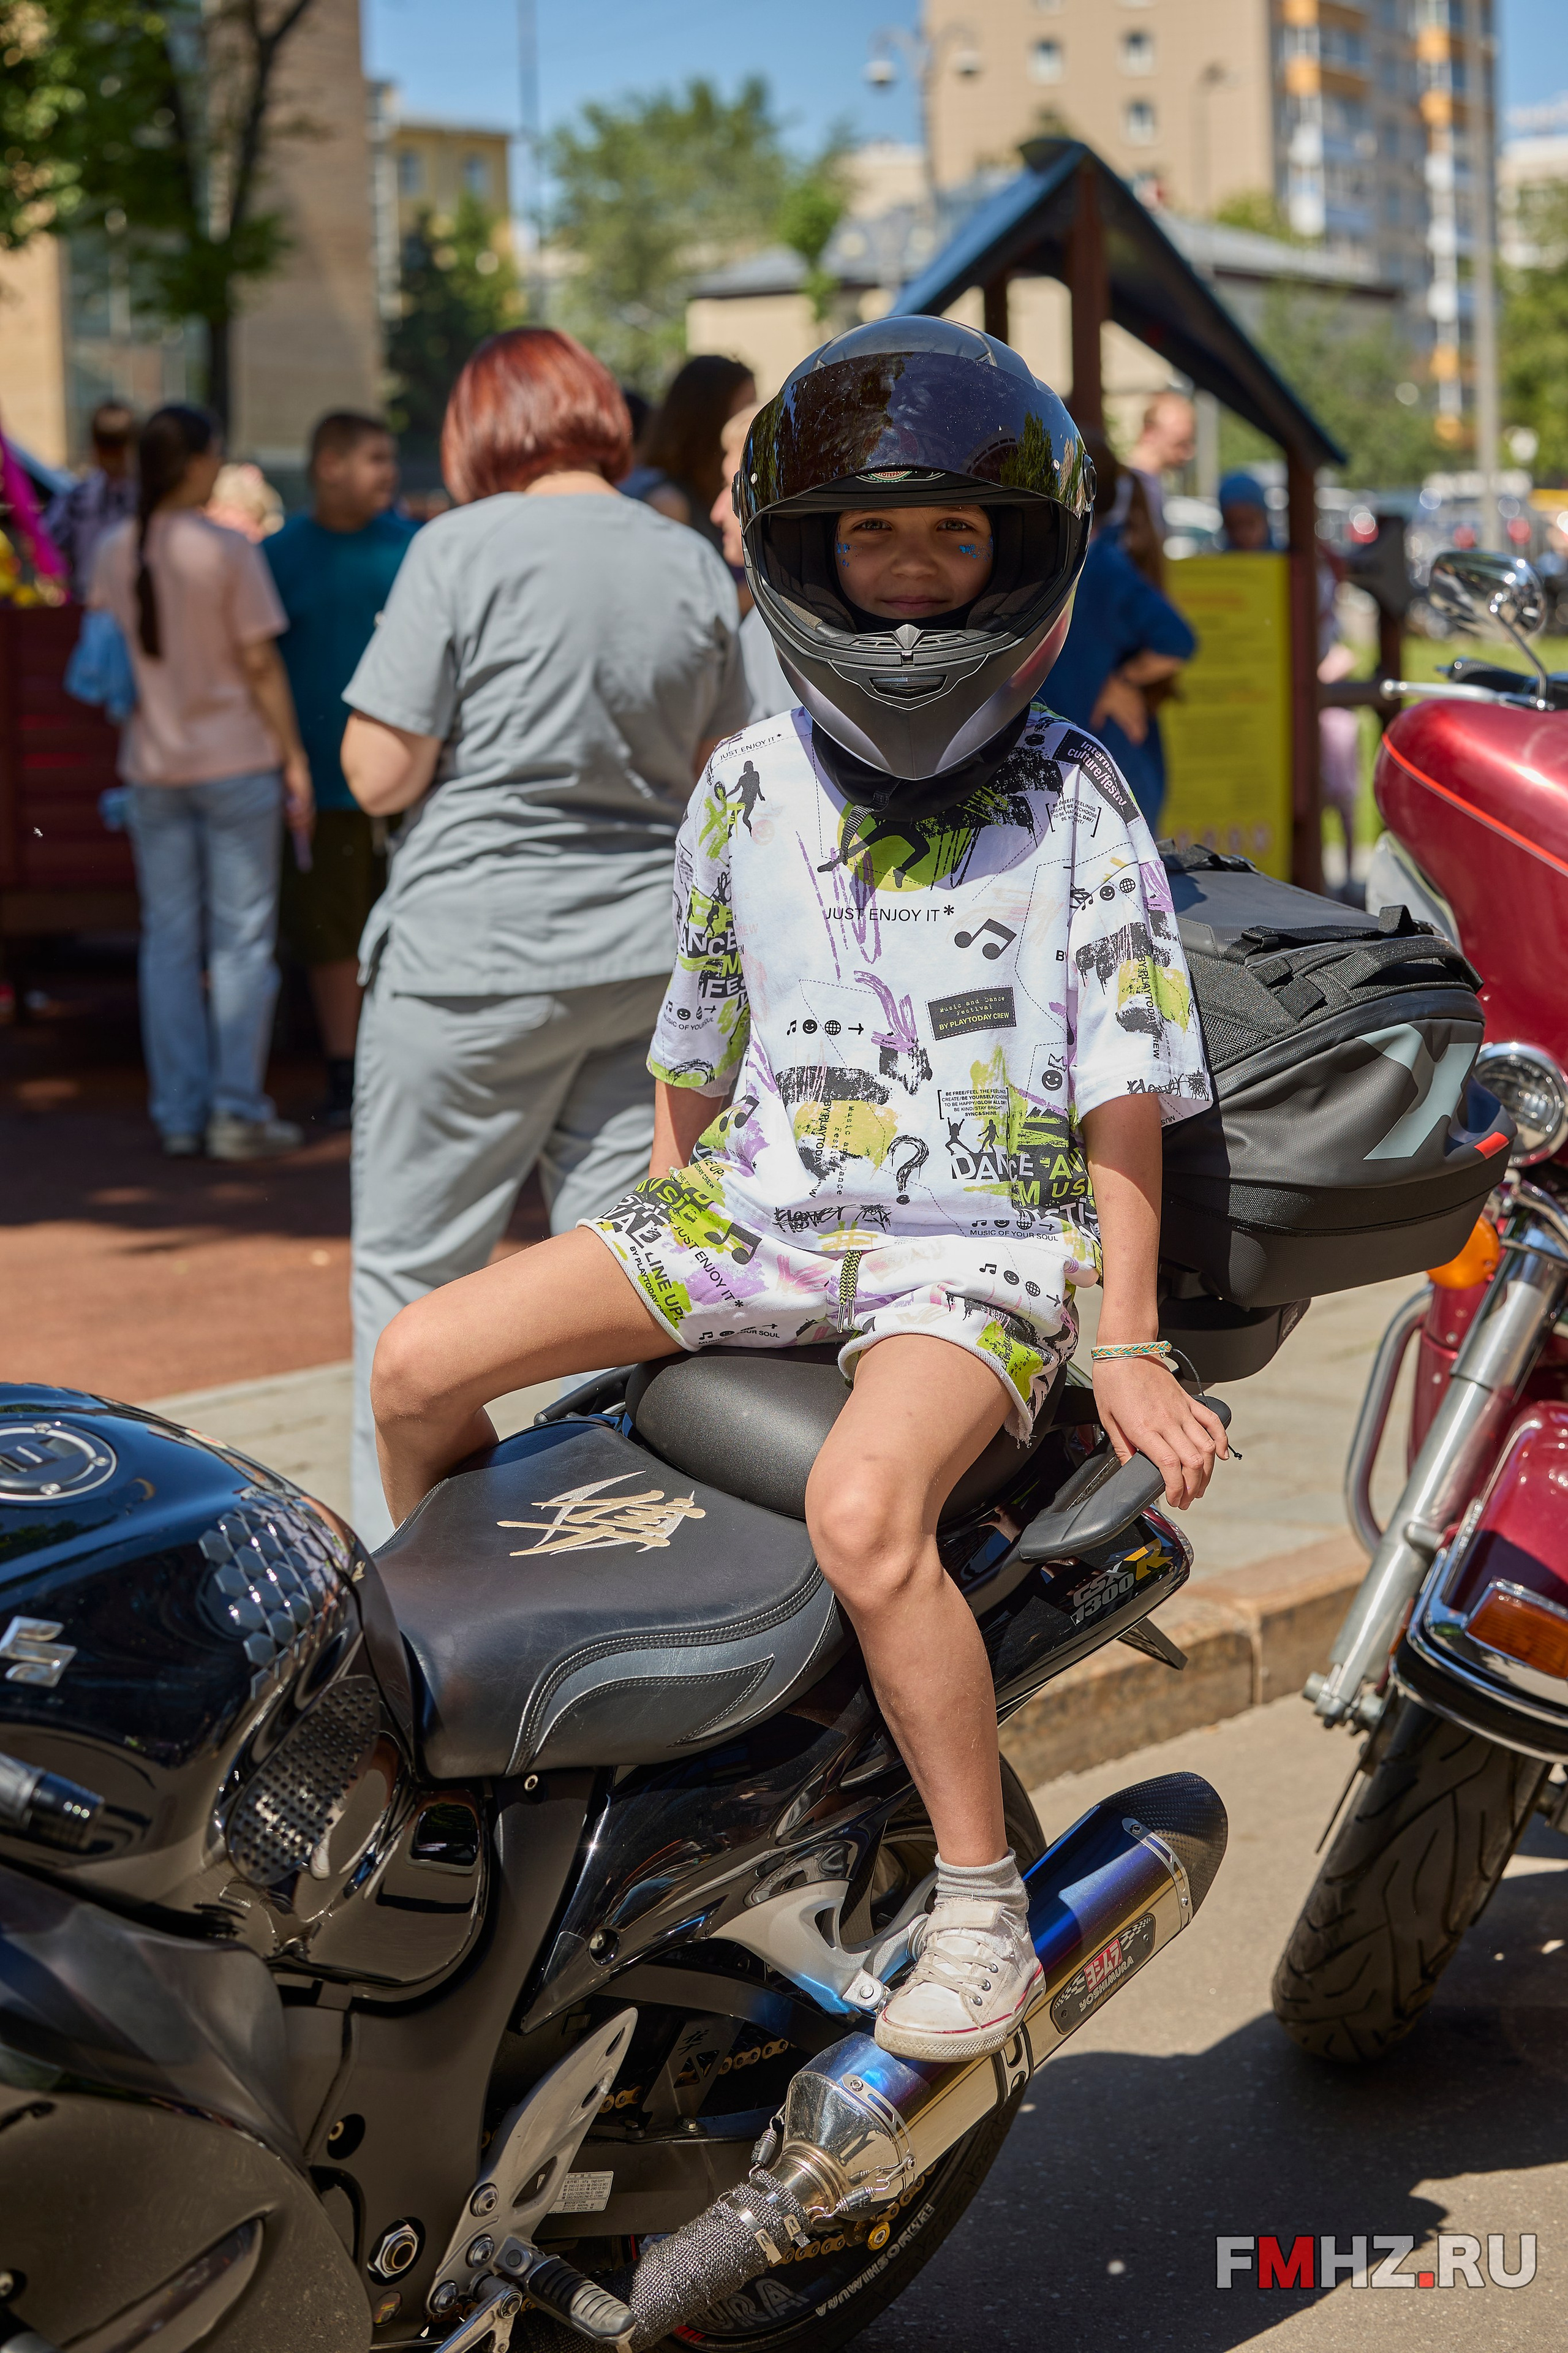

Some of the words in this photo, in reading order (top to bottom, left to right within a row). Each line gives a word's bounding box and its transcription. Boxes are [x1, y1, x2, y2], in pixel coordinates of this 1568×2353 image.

[720, 749, 738, 760] JUST
[741, 739, 766, 752] ENJOY
[1074, 806, 1097, 818] F/CHOOSE
[826, 907, 865, 920] JUST
[870, 908, 922, 921] ENJOY
[678, 924, 736, 956] ANCE
[940, 1003, 962, 1013] Music
[957, 1005, 993, 1016] Festival
[1141, 970, 1156, 1025] PLAYTODA
[950, 1014, 992, 1027] PLAYTODAY
[845, 1106, 854, 1135] Music
[815, 1113, 830, 1165] PLAYTODA
[702, 1174, 715, 1189] CREW
[645, 1252, 673, 1292] LINE
[674, 1226, 699, 1250] JUST
[695, 1251, 726, 1288] ENJOY
[630, 1246, 639, 1256] BY
[635, 1258, 659, 1303] PLAYTODAY
[1071, 1573, 1134, 1626] 1300
[1079, 1955, 1134, 2012] YOSHIMURA
[815, 2230, 913, 2316] YOSHIMURA
